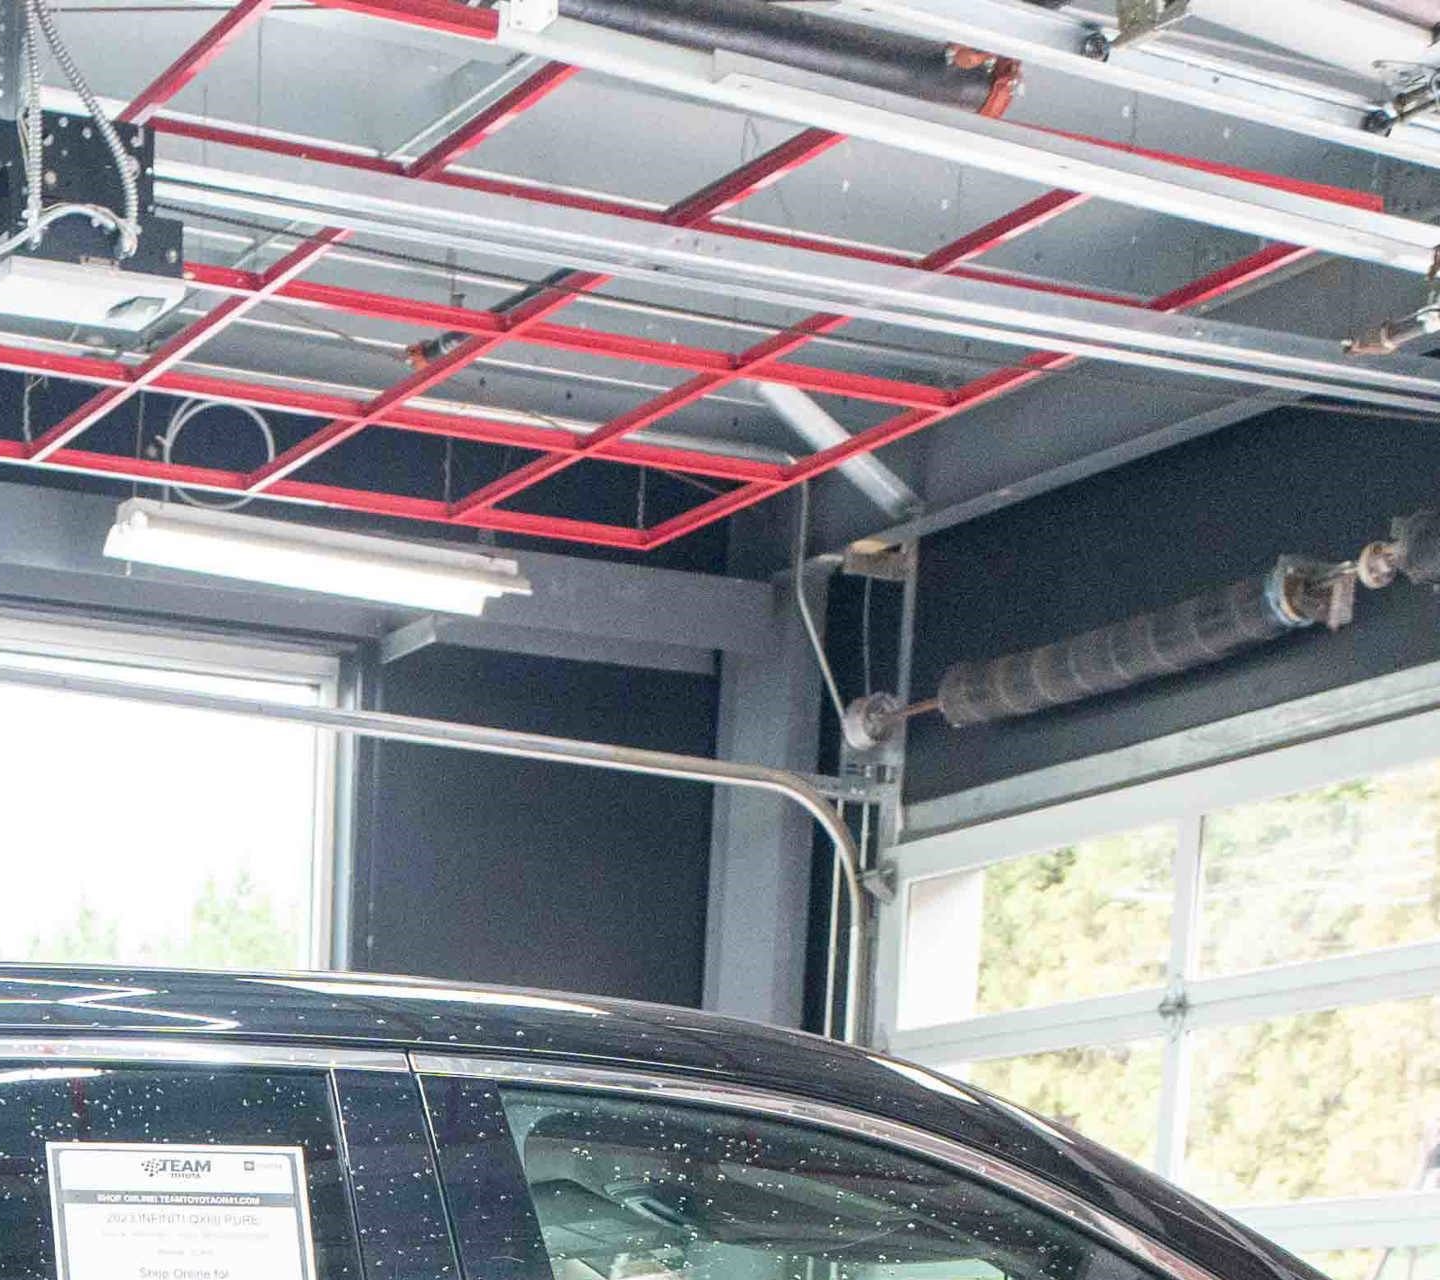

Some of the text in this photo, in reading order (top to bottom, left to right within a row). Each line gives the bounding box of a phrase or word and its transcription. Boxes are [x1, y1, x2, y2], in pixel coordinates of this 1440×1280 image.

[160, 1159, 212, 1173] TEAM
[97, 1194, 122, 1203] SHOP
[139, 1267, 169, 1280] Shop
[174, 1268, 211, 1280] Online
